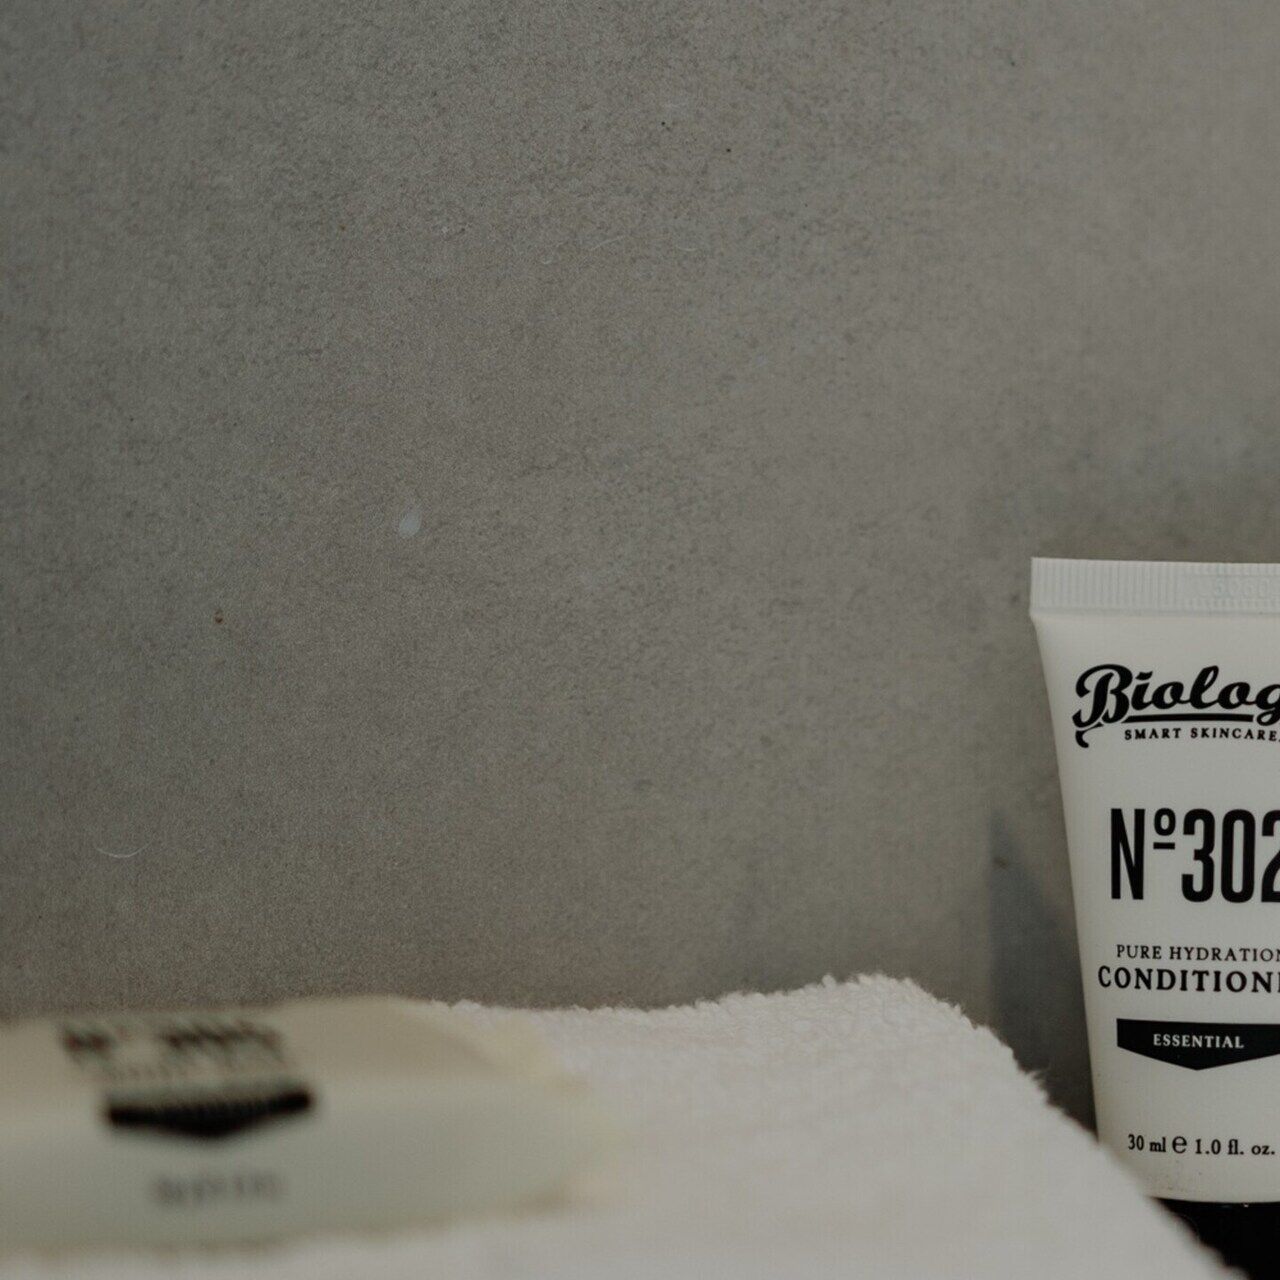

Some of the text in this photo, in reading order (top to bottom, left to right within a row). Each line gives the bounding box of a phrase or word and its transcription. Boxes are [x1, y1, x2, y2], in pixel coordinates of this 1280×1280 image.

[1124, 727, 1181, 741] SMART
[1116, 944, 1162, 960] PURE
[1153, 1033, 1244, 1049] ESSENTIAL
[1128, 1134, 1145, 1151] 30
[1149, 1137, 1166, 1153] ml
[1195, 1139, 1221, 1156] 1.0
[1227, 1139, 1244, 1156] fl.
[1251, 1143, 1276, 1157] oz.
